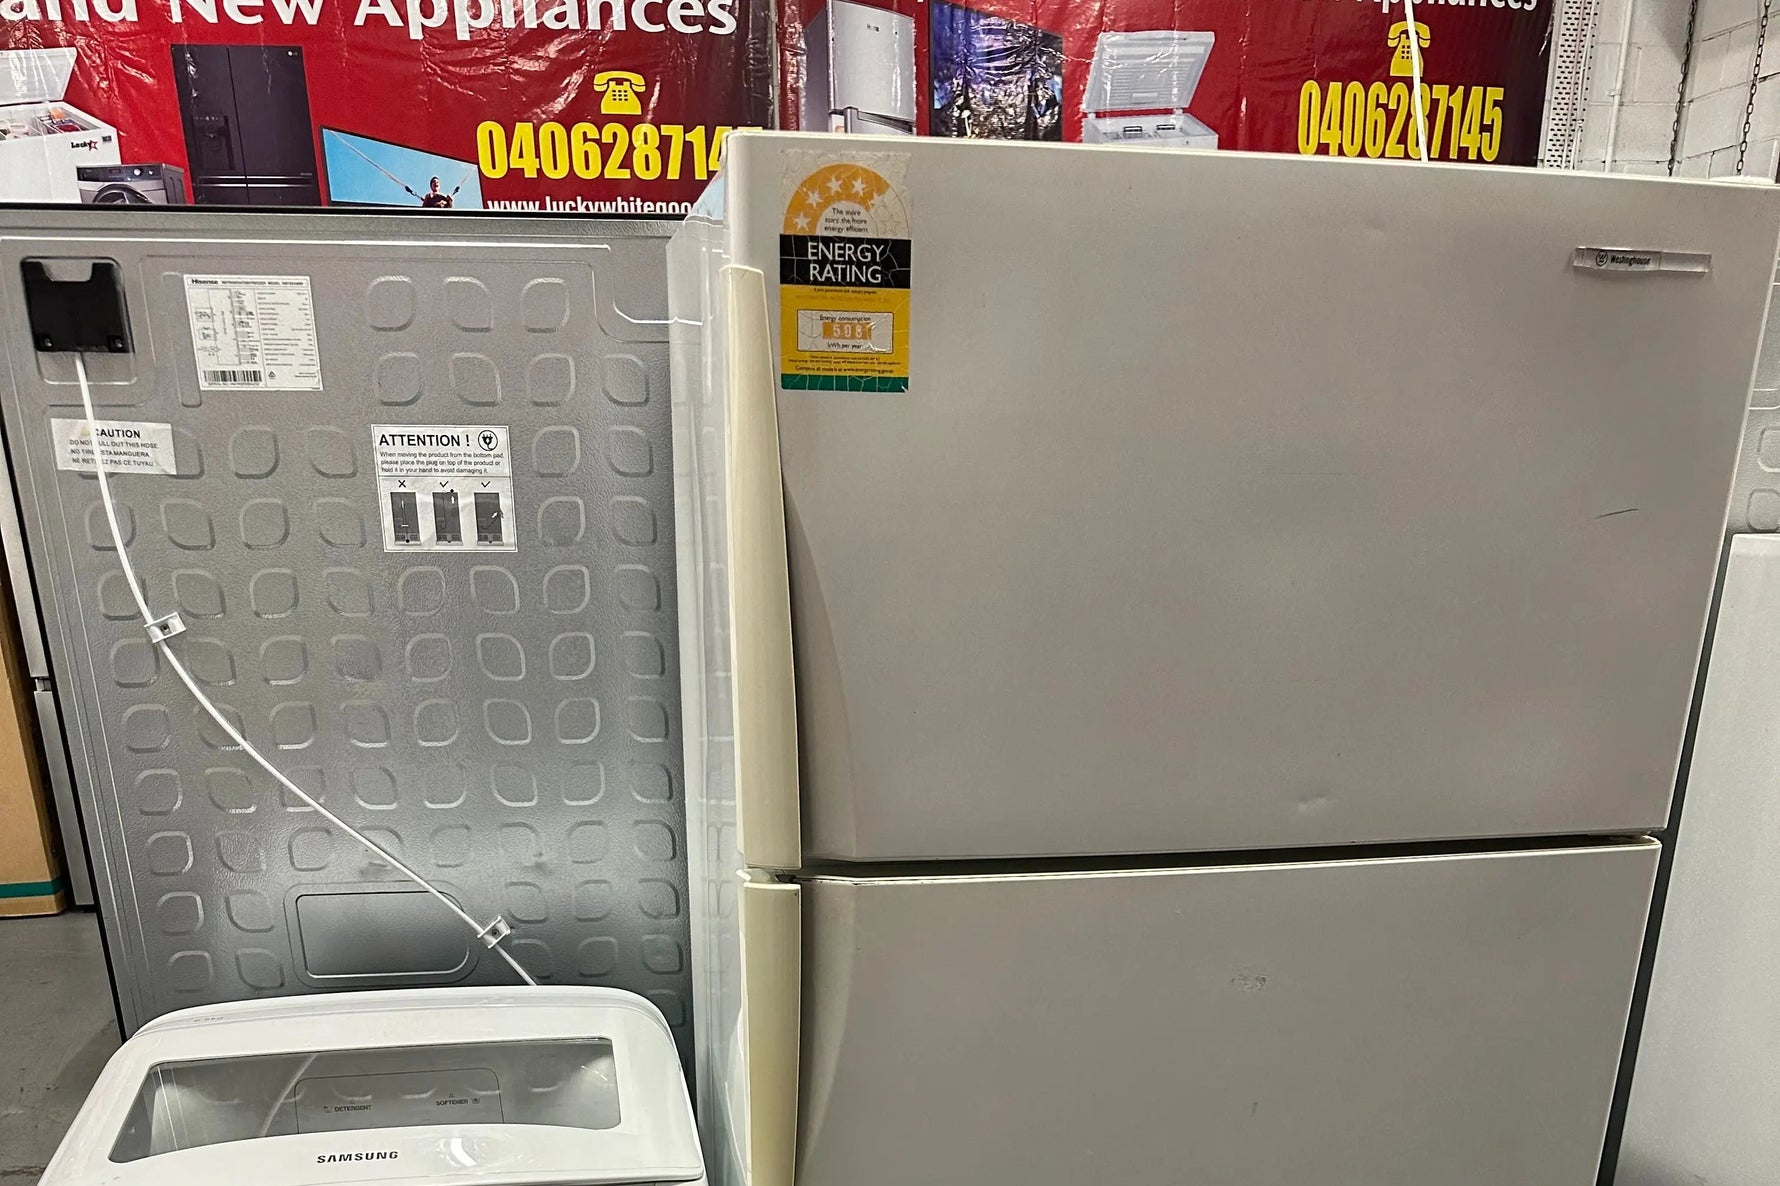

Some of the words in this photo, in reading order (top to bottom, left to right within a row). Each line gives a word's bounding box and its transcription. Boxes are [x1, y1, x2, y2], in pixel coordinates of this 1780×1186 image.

[169, 0, 324, 25] New
[353, 0, 738, 41] Appliances
[1298, 79, 1504, 162] 0406287145
[476, 120, 763, 181] 040628714
[808, 241, 884, 262] ENERGY
[1610, 254, 1651, 267] Westinghouse
[810, 263, 882, 283] RATING
[379, 434, 461, 447] ATTENTION
[466, 434, 470, 447] !
[334, 1104, 372, 1112] DETERGENT
[316, 1151, 398, 1164] SAMSUNG
